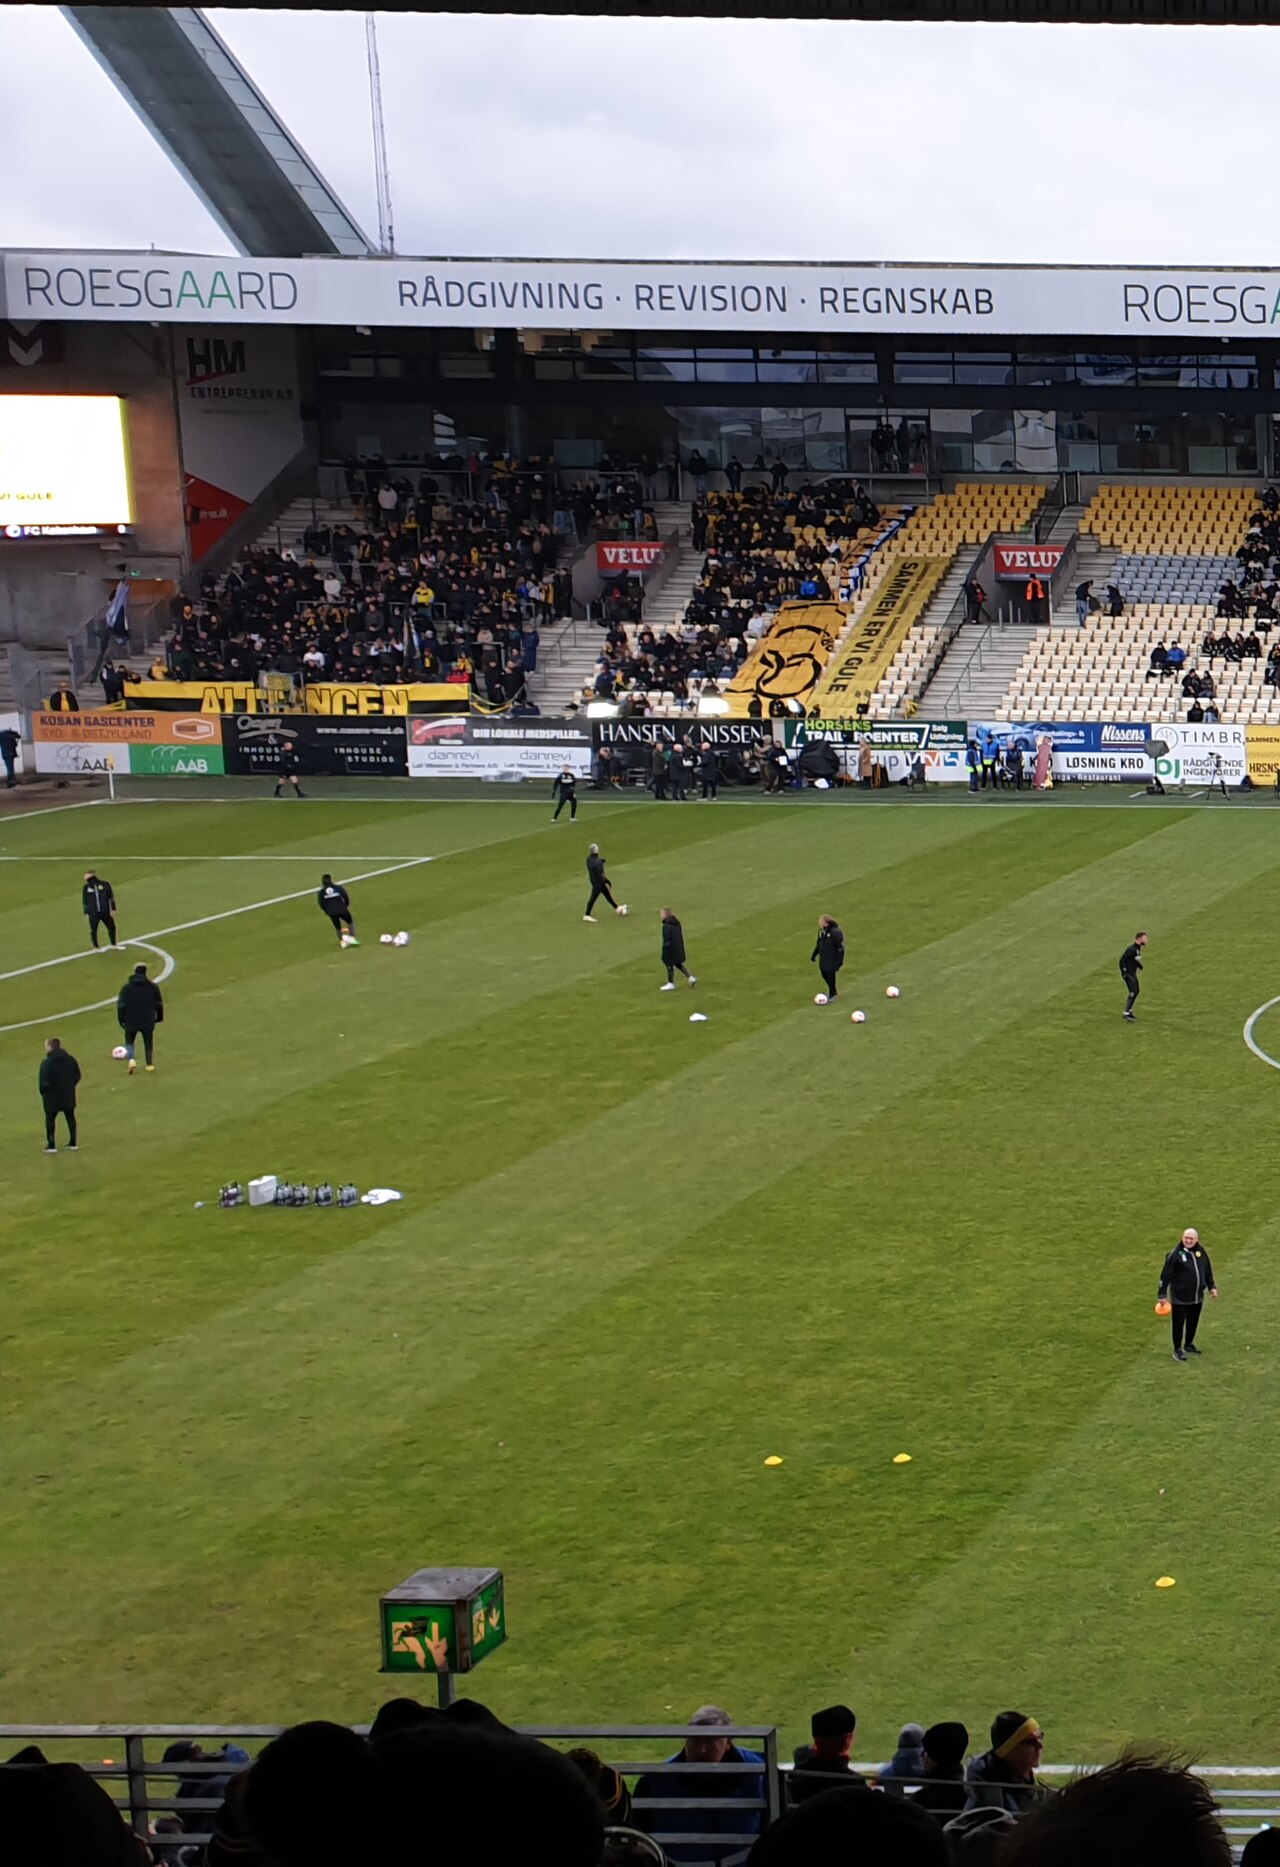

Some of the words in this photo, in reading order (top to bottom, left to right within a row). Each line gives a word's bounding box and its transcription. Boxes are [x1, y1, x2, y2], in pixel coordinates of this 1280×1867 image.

[25, 267, 298, 311] ROESGAARD
[399, 276, 603, 311] RÅDGIVNING
[635, 283, 787, 313] REVISION
[820, 287, 994, 315] REGNSKAB
[187, 337, 246, 378] HM
[1000, 551, 1064, 568] VELUX
[872, 561, 919, 617] SAMMEN
[860, 620, 887, 637] ER
[850, 640, 874, 653] VI
[40, 715, 82, 727] KOSAN
[84, 716, 155, 728] GASCENTER
[804, 720, 872, 731] HORSENS
[600, 724, 675, 742] HANSEN
[700, 724, 764, 744] NISSEN
[804, 731, 919, 743] TRAILRCENTER
[1101, 725, 1146, 742] Nissens
[1180, 731, 1245, 744] TIMBR
[251, 755, 300, 763] STUDS
[1066, 757, 1118, 769] LØSNING
[1121, 757, 1144, 769] KRO
[175, 759, 208, 773] AAB
[1249, 763, 1279, 773] HRSNS
[1077, 773, 1121, 782] Restaurant
